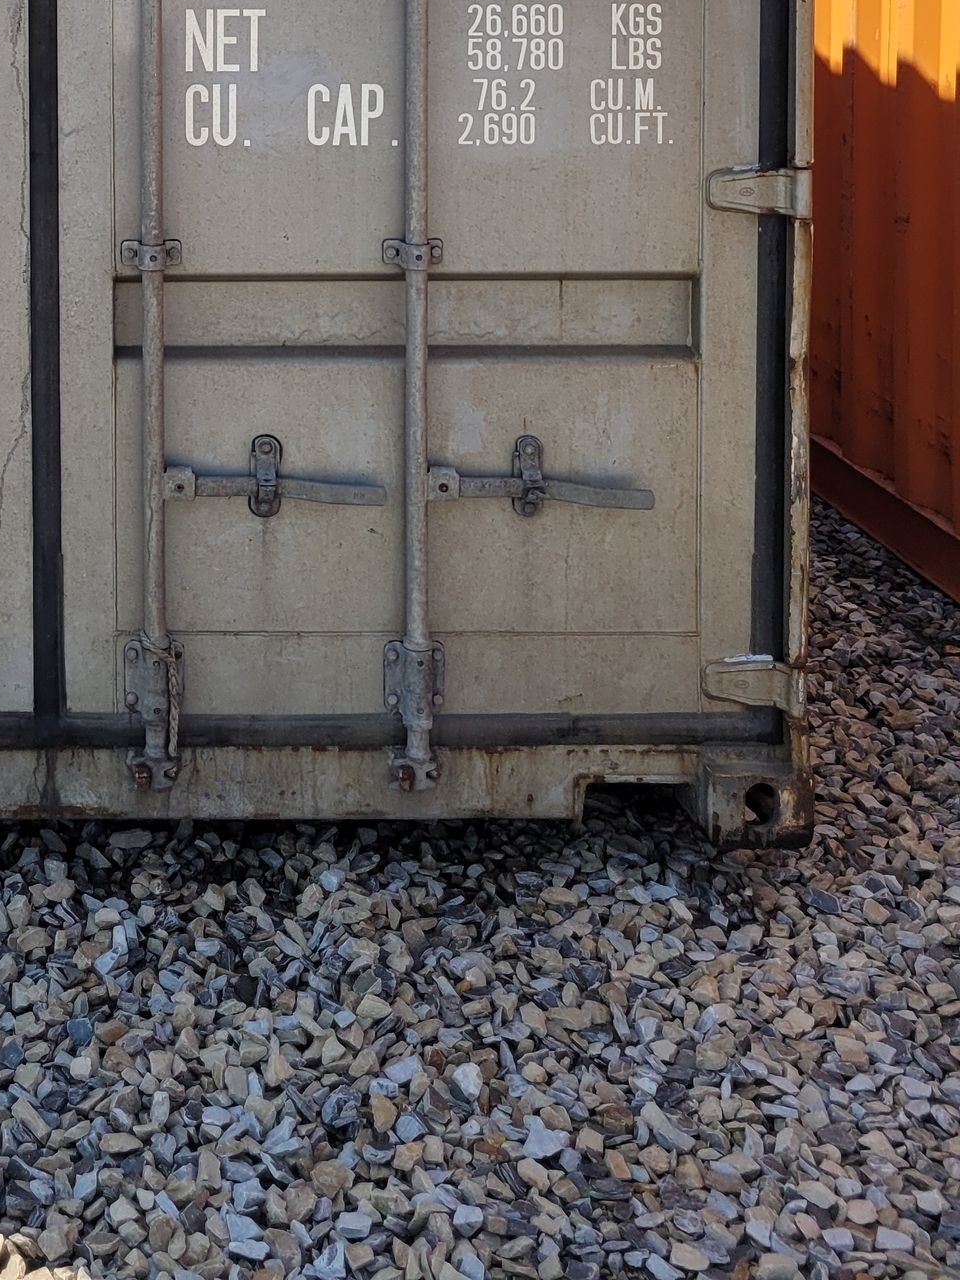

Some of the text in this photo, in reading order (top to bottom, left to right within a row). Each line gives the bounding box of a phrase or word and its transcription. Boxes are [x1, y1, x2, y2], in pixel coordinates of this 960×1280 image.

[467, 3, 663, 38] 26,660 KGS
[185, 8, 267, 73] NET
[467, 37, 663, 72] 58,780 LBS
[472, 77, 663, 112] 76.2 CU.M.
[185, 83, 398, 147] CU. CAP.
[458, 112, 675, 147] 2,690 CU.FT.
